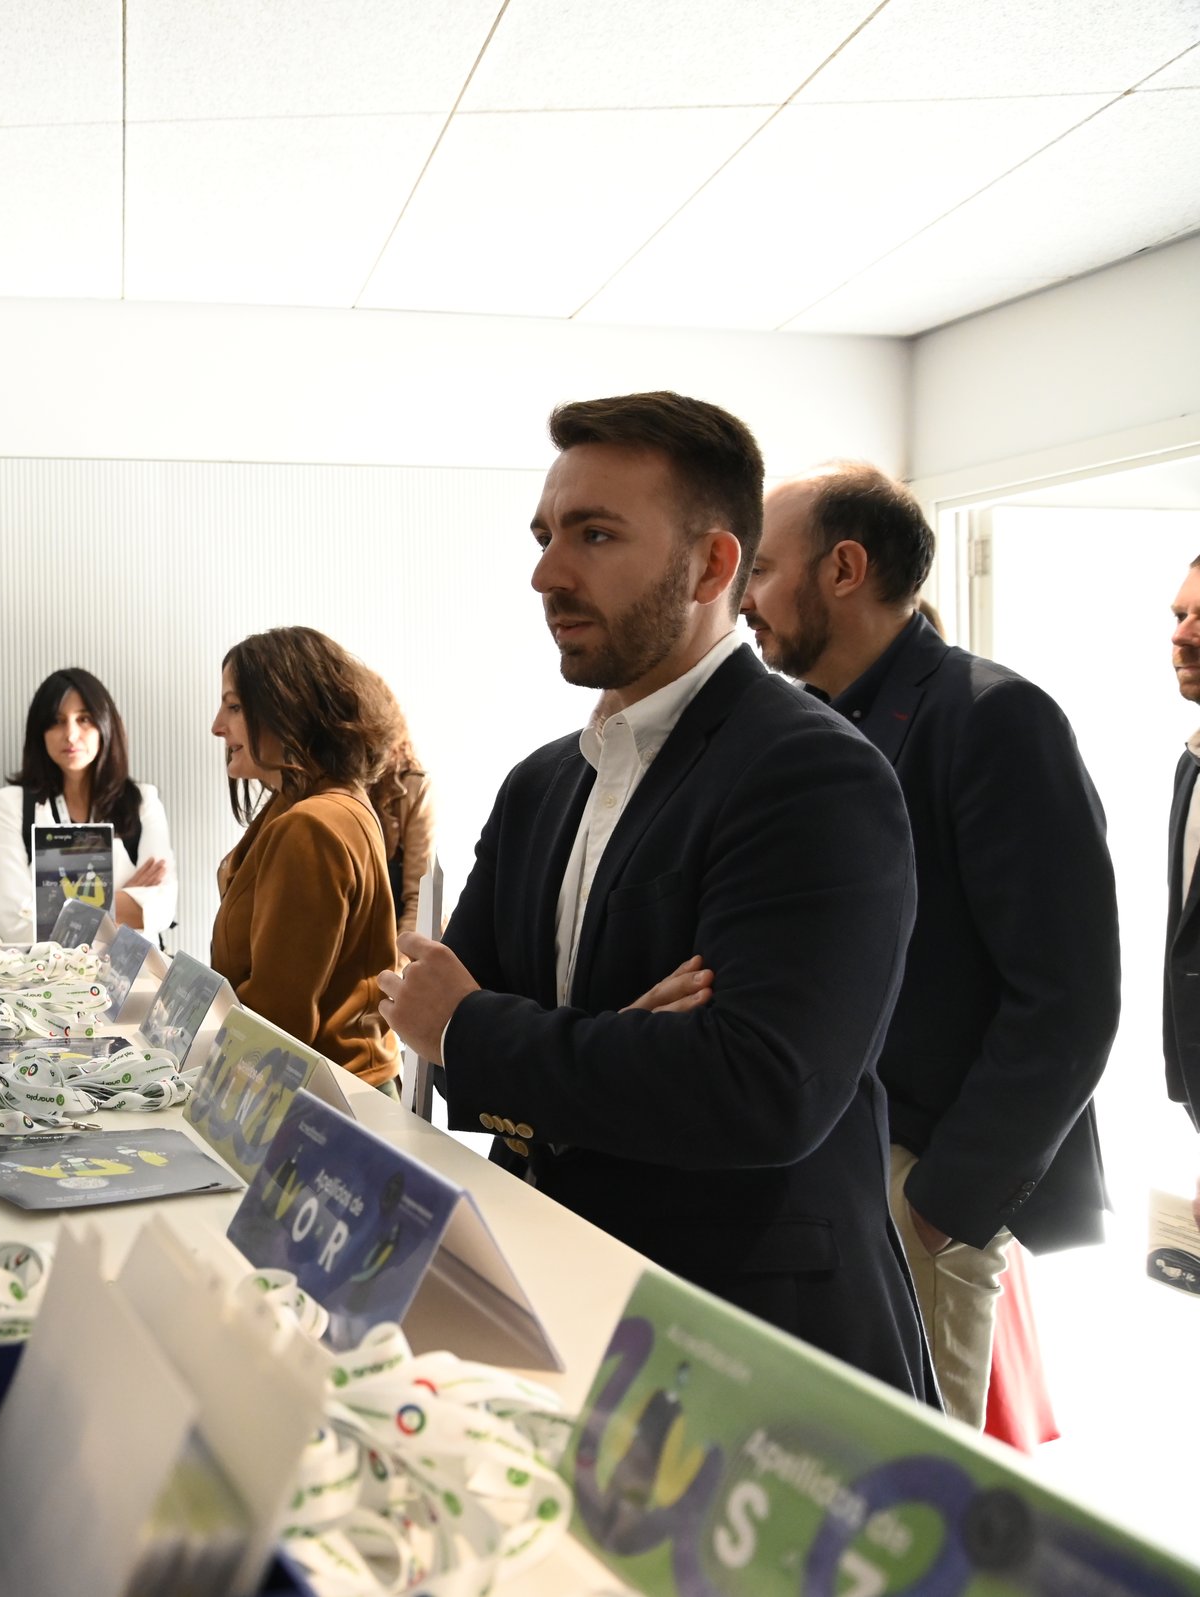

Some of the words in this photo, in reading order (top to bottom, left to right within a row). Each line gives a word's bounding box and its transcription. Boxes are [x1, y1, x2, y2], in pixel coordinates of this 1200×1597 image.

[25, 1092, 55, 1103] anarpla
[235, 1087, 256, 1126] N
[314, 1168, 352, 1208] Apellidos
[349, 1195, 364, 1217] de
[292, 1196, 318, 1242] O
[317, 1219, 349, 1273] R
[744, 1428, 867, 1532] Apellidos
[864, 1510, 911, 1557] de
[713, 1480, 769, 1569] S
